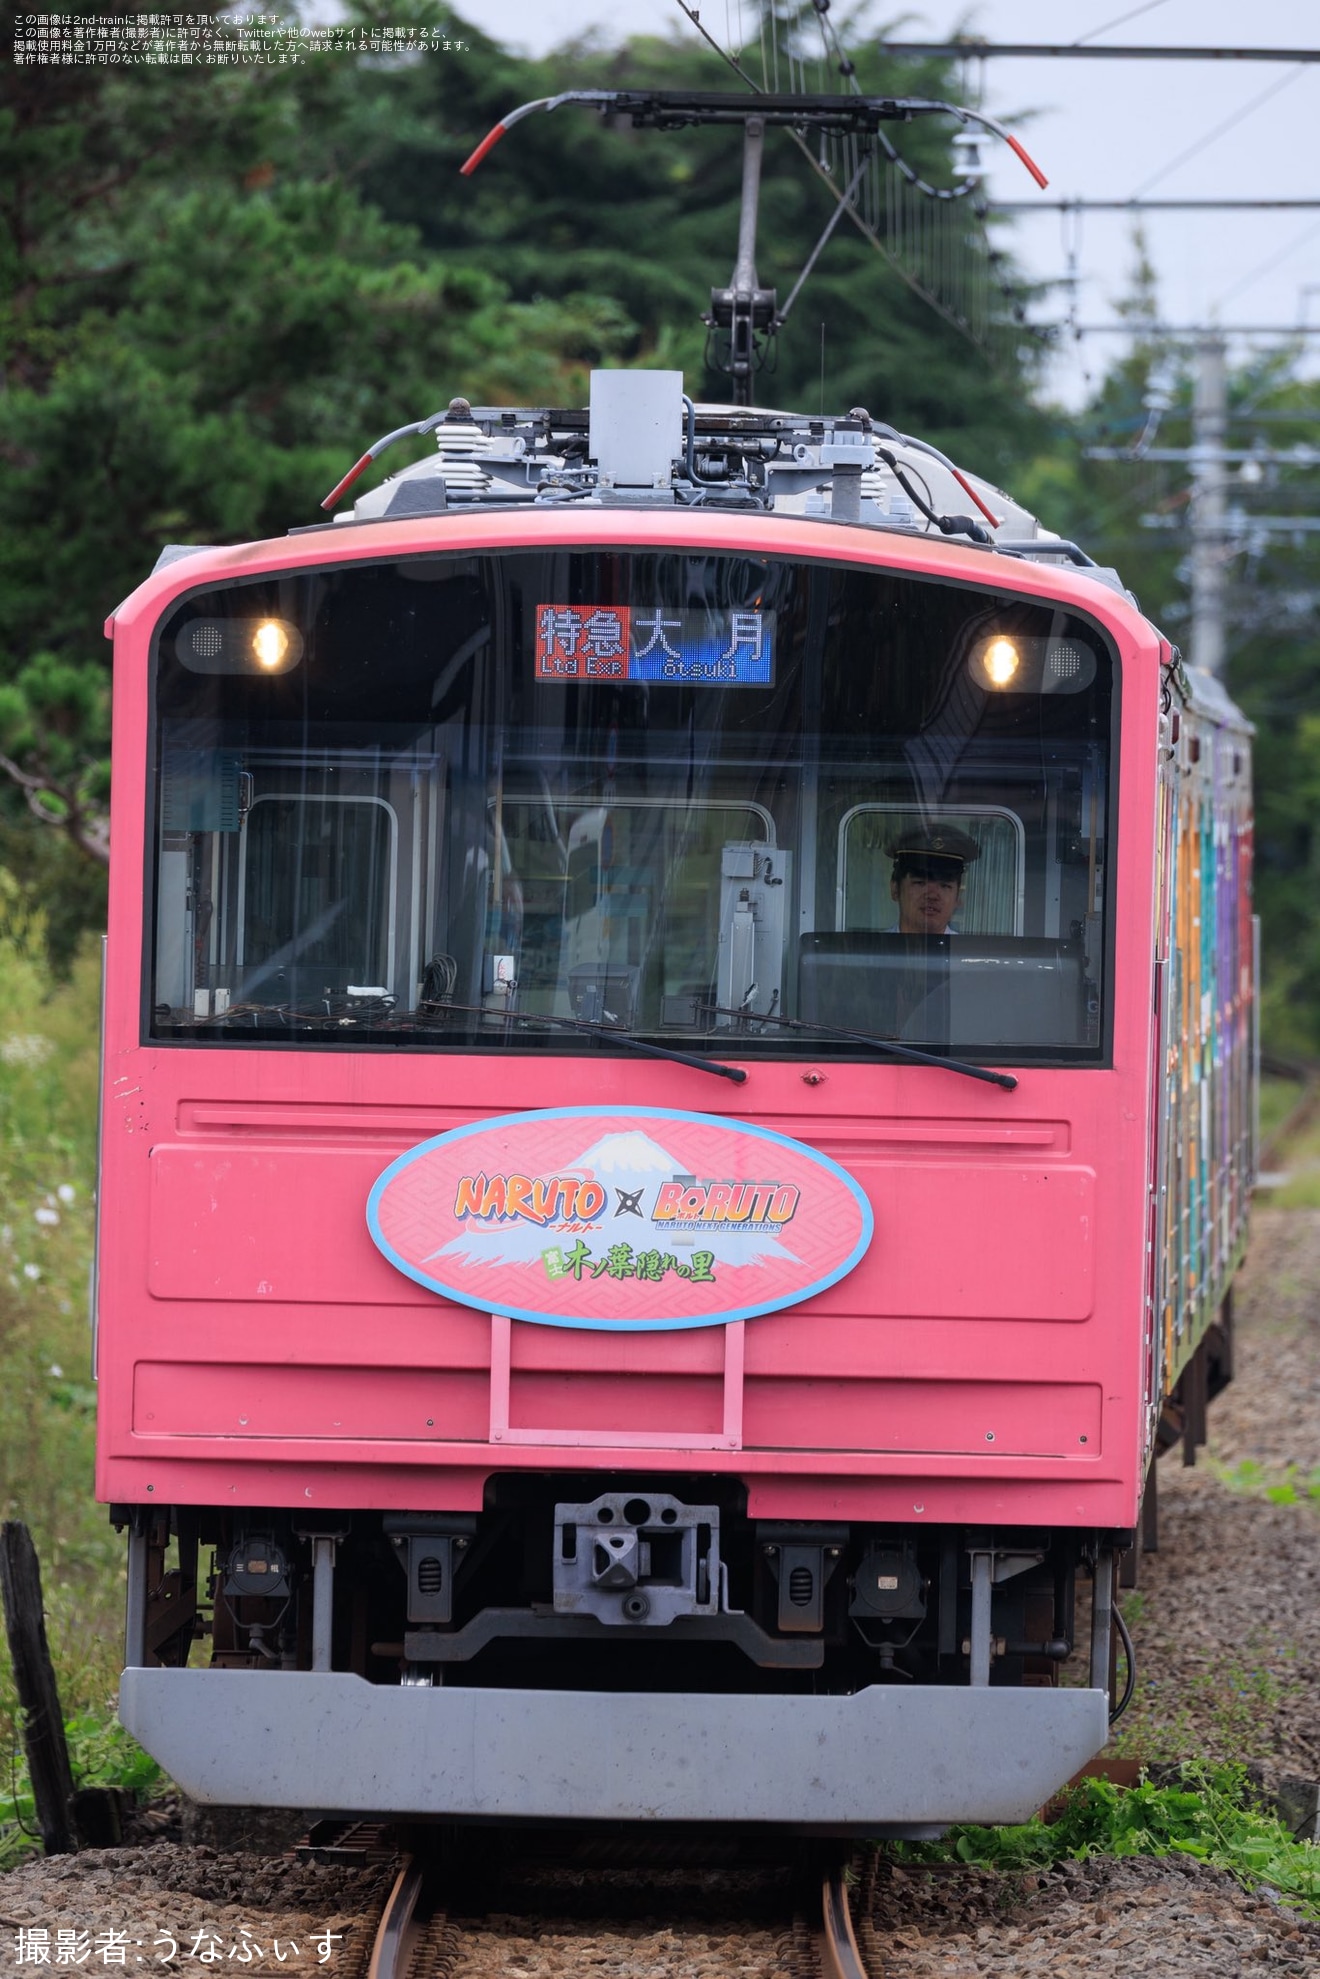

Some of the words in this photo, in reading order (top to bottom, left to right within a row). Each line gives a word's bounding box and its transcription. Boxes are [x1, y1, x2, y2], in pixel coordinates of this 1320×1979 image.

[540, 608, 625, 657] 特急
[454, 1171, 607, 1227] NARUTO
[651, 1182, 800, 1224] BORUTO
[656, 1221, 694, 1231] NARUTO
[695, 1222, 718, 1232] NEXT
[719, 1223, 782, 1233] GENERATIONS
